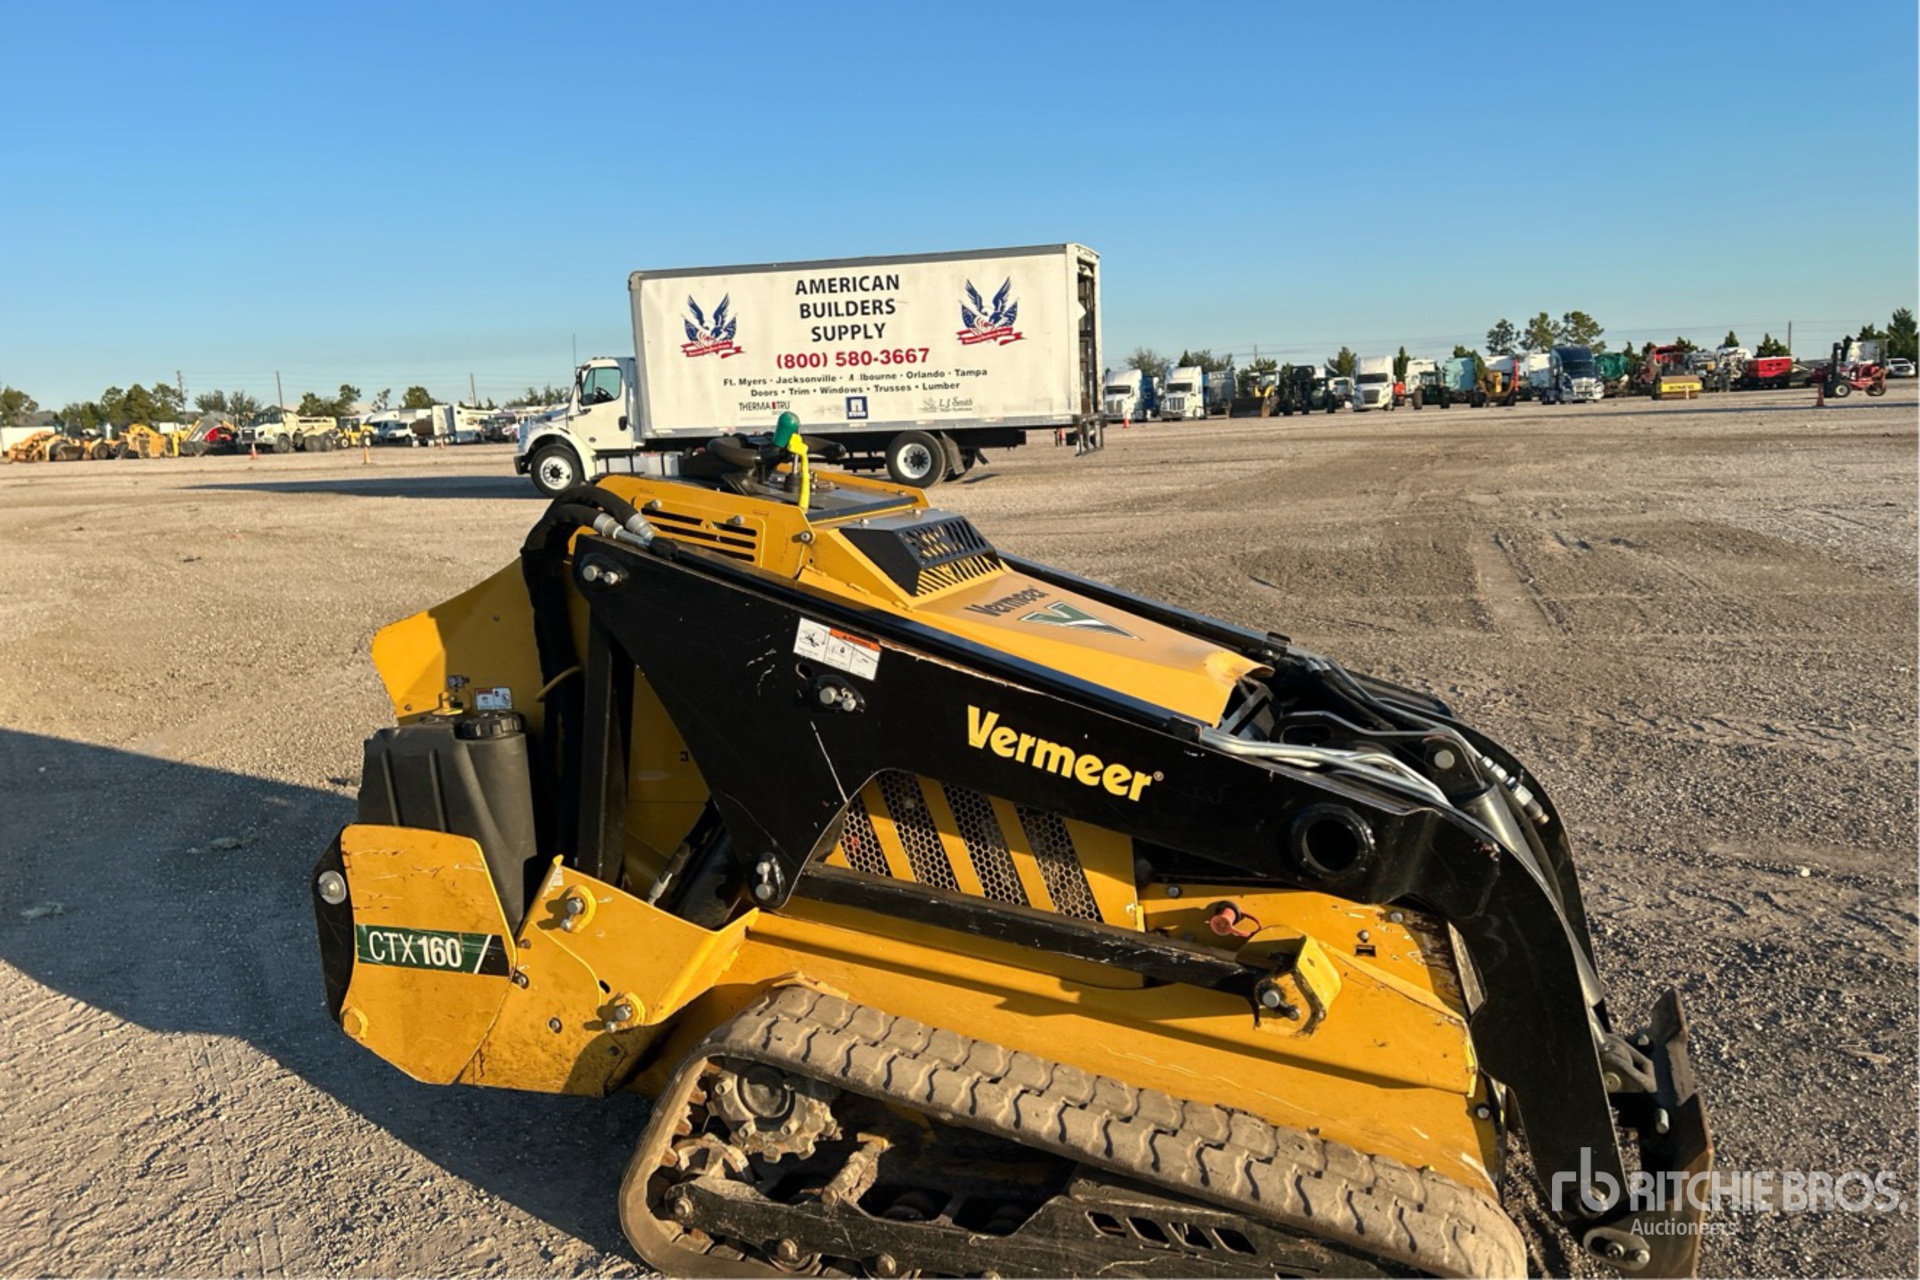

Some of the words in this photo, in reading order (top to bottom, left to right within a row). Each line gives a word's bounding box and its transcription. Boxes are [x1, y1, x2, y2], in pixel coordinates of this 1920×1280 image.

[795, 274, 900, 295] AMERICAN
[800, 298, 896, 319] BUILDERS
[811, 322, 886, 342] SUPPLY
[776, 352, 828, 369] (800)
[835, 347, 930, 367] 580-3667
[723, 378, 736, 386] Ft.
[738, 377, 767, 387] Myers
[776, 374, 837, 384] Jacksonville
[849, 373, 897, 381] lbourne
[905, 370, 946, 379] Orlando
[954, 368, 988, 378] Tampa
[751, 389, 779, 397] Doors
[788, 387, 811, 395] Trim
[820, 385, 864, 394] Windows
[873, 384, 912, 393] Trusses
[922, 382, 960, 391] Lumber
[963, 588, 1050, 617] Vermeer
[368, 930, 463, 968] CTX160
